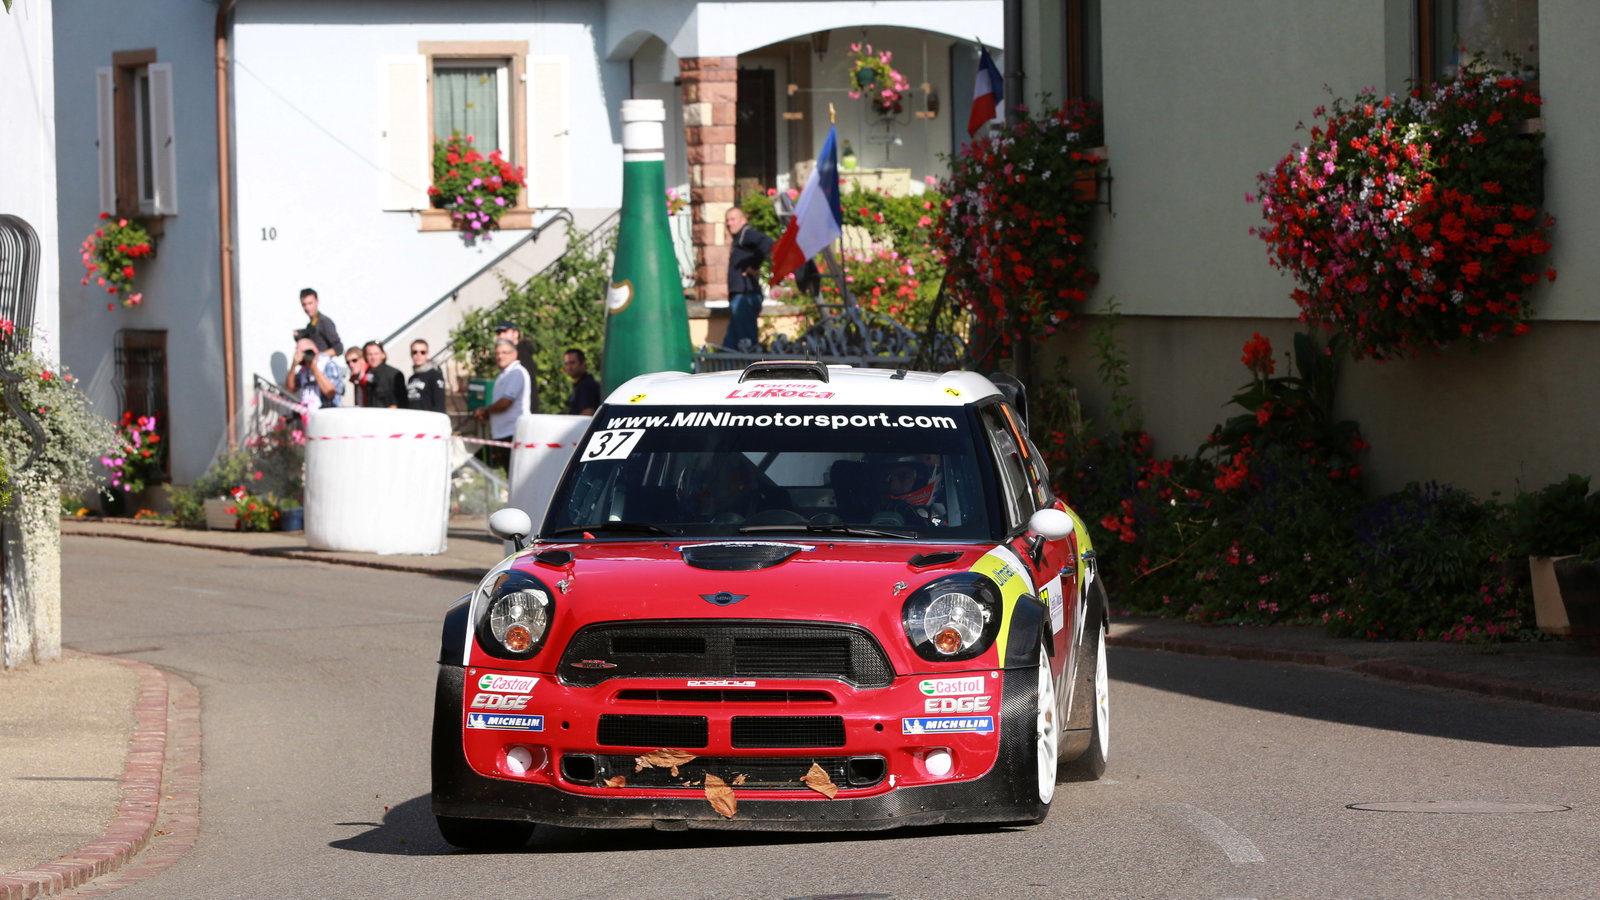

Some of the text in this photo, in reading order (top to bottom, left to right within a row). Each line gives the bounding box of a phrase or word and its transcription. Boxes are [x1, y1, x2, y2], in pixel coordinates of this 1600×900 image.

[261, 227, 277, 241] 10
[725, 389, 836, 400] LaRoca
[606, 412, 958, 430] www.MINImotorsport.com
[589, 431, 635, 458] 37
[491, 677, 533, 691] Castrol
[936, 679, 981, 693] Castrol
[471, 693, 534, 710] EDGE
[924, 696, 992, 713] EDGE
[487, 717, 540, 727] MICHELIN
[925, 720, 988, 729] MICHELIN
